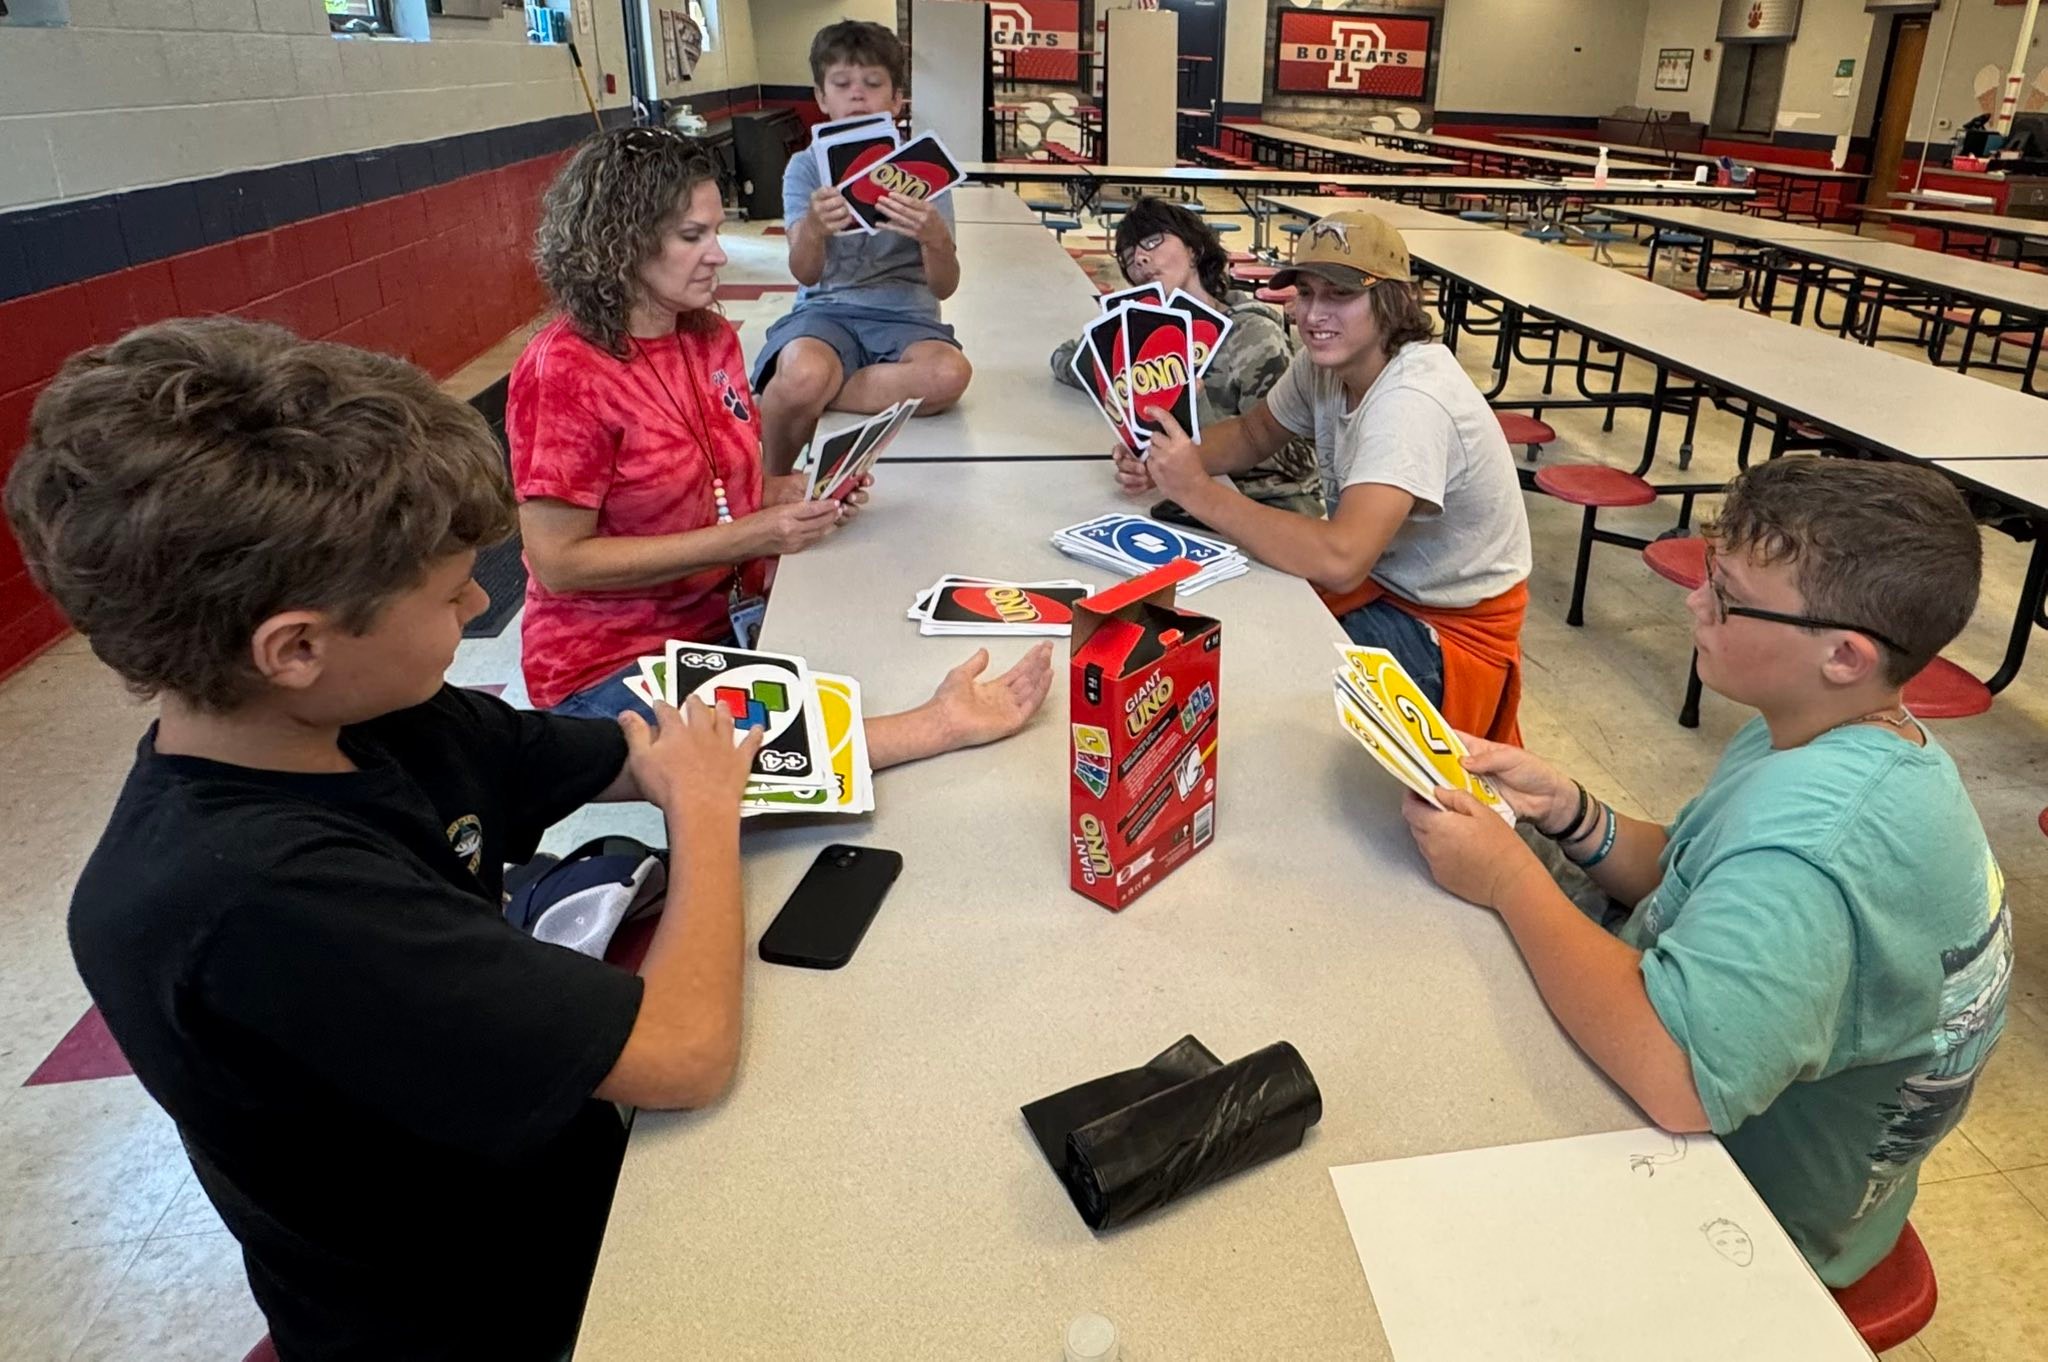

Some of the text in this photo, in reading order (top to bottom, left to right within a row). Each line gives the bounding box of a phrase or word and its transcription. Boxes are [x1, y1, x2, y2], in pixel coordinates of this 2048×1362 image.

[993, 31, 1059, 46] CATS
[1297, 47, 1408, 64] BOBCATS
[869, 162, 931, 200] UNO
[1131, 352, 1189, 395] UNO
[985, 587, 1041, 623] UNO
[681, 652, 727, 671] +4
[1351, 655, 1378, 682] 2
[1125, 668, 1161, 713] GIANT
[1126, 676, 1174, 739] UNO
[1395, 694, 1453, 755] 2
[760, 749, 808, 771] +4
[1073, 833, 1096, 885] GIANT
[1079, 813, 1114, 878] UNO
